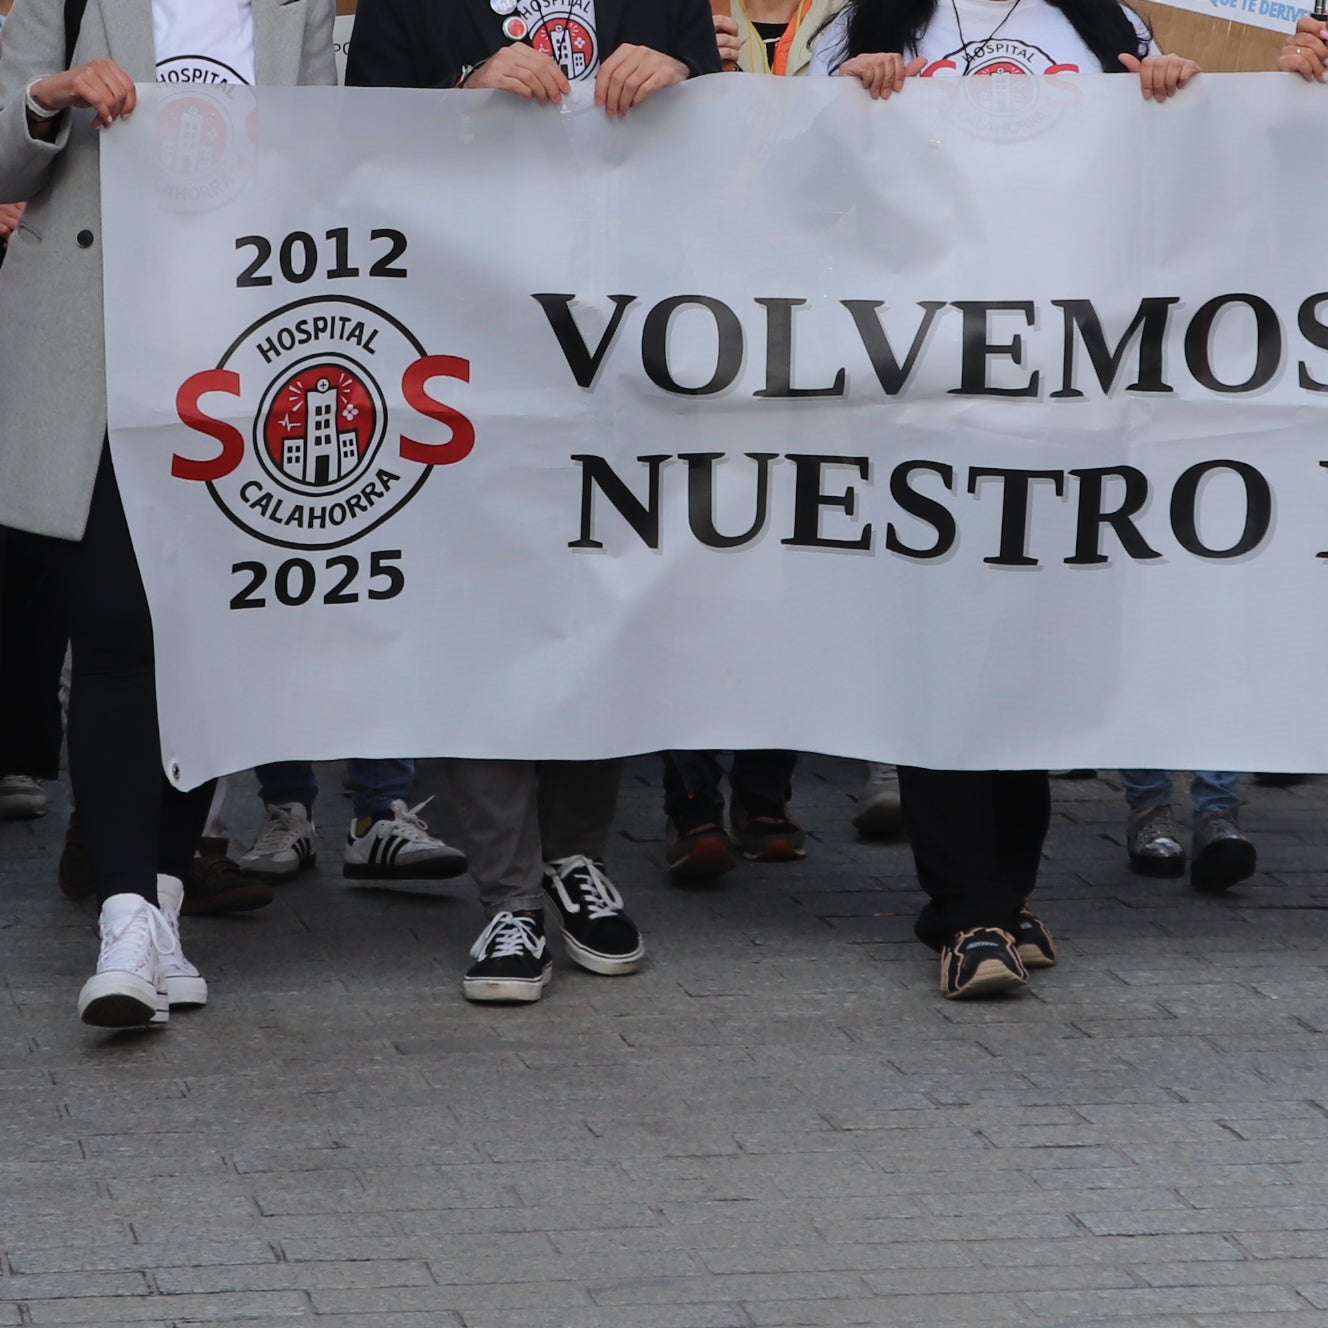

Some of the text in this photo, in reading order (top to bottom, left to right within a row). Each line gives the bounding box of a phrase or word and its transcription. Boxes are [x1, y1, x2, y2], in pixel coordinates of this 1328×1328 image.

[962, 43, 1036, 64] HOSPITAL
[234, 227, 409, 288] 2012
[256, 315, 380, 364] HOSPITAL
[239, 468, 401, 529] CALAHORRA
[567, 451, 1273, 567] NUESTRO
[229, 549, 406, 610] 2025
